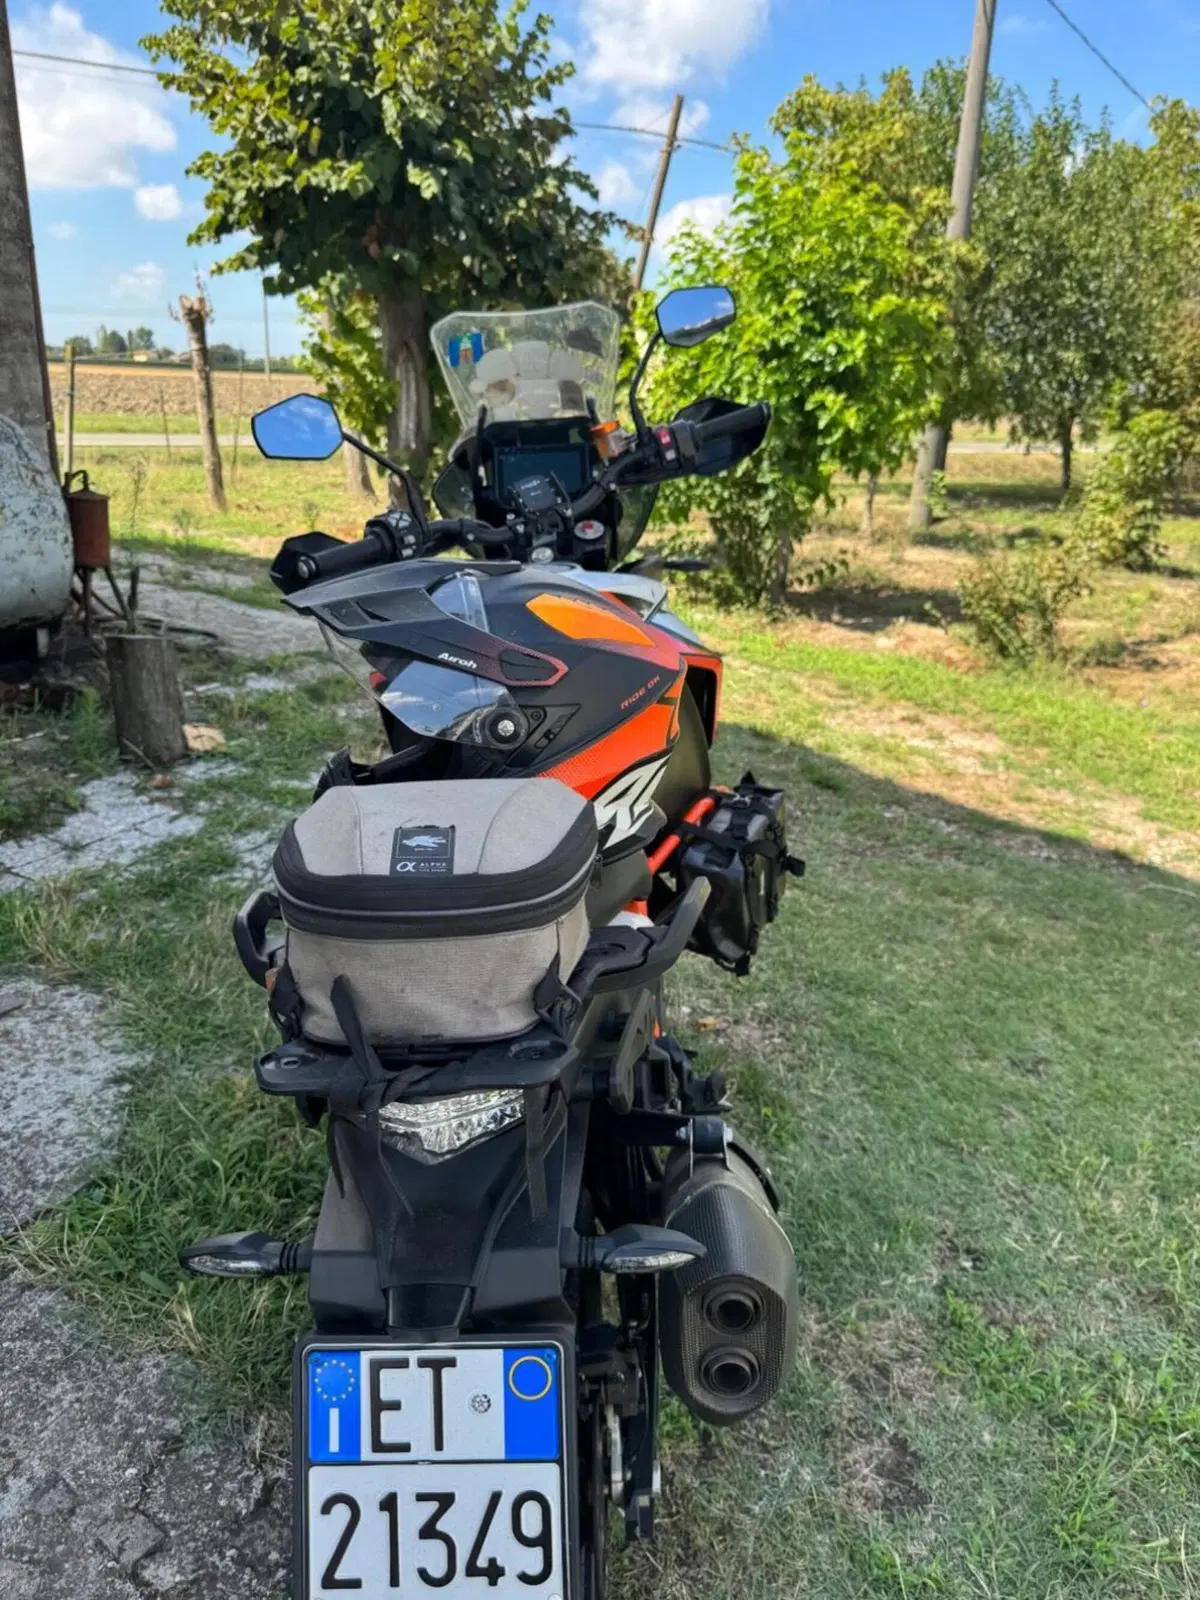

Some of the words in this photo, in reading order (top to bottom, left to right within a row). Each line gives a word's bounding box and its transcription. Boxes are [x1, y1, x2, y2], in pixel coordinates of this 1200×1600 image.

[437, 652, 478, 669] Airoh
[328, 1407, 340, 1453] I
[368, 1356, 458, 1454] ET
[319, 1488, 553, 1590] 21349
